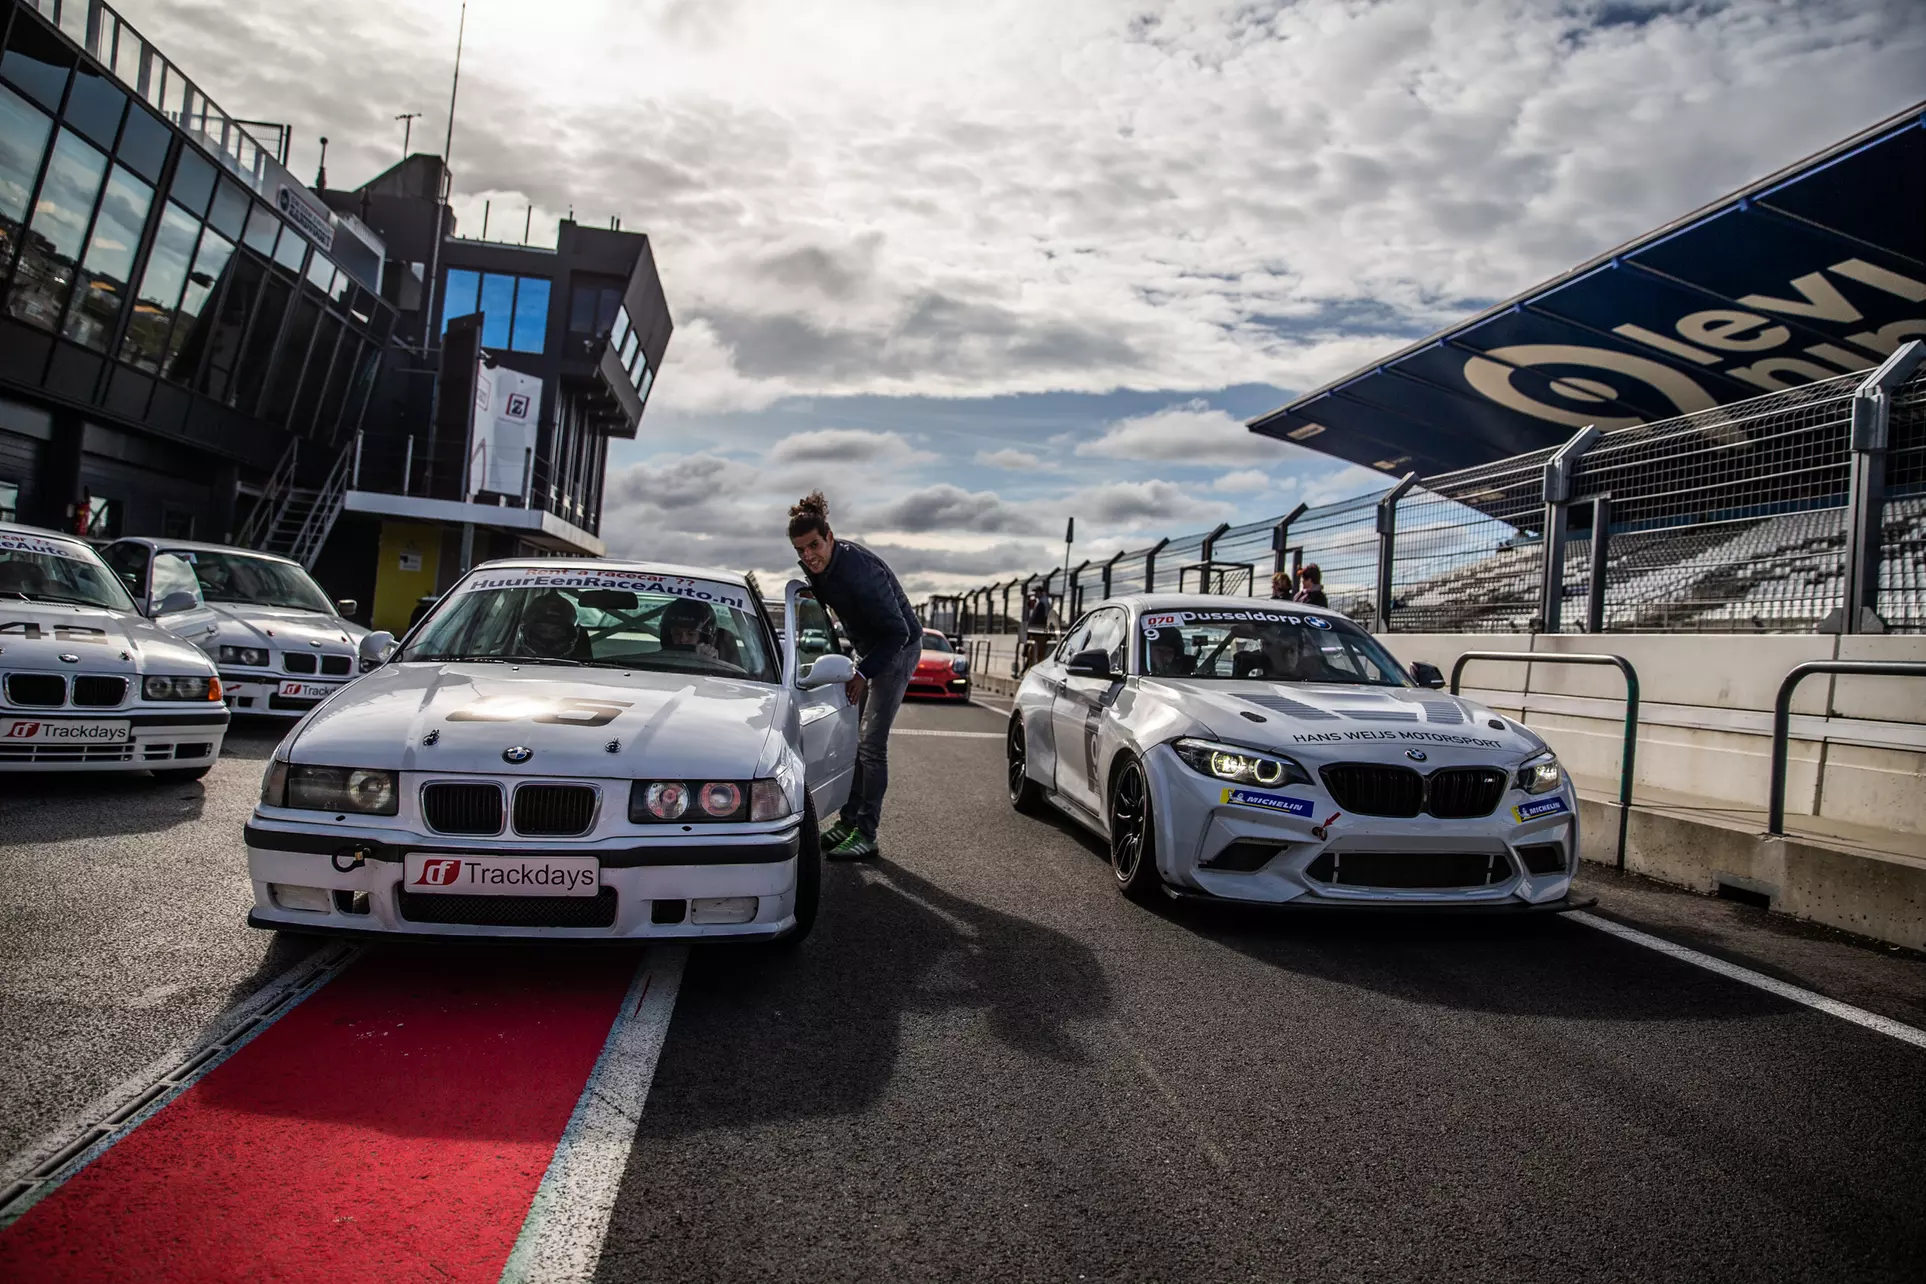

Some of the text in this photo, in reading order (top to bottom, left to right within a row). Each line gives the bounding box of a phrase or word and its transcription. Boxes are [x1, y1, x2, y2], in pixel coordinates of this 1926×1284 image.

[596, 571, 667, 582] racecar
[675, 576, 696, 587] ??
[469, 576, 744, 609] HuurEenRaceAuto.nl
[1148, 616, 1175, 625] 070
[1181, 611, 1302, 626] Dusseldorp
[1144, 628, 1160, 641] 9
[42, 723, 127, 741] Trackdays
[1293, 731, 1502, 749] HANS WEIJS MOTORSPORT
[1246, 796, 1304, 811] MICHELIN
[1529, 801, 1561, 815] MICHELIN
[464, 862, 595, 891] Trackdays
